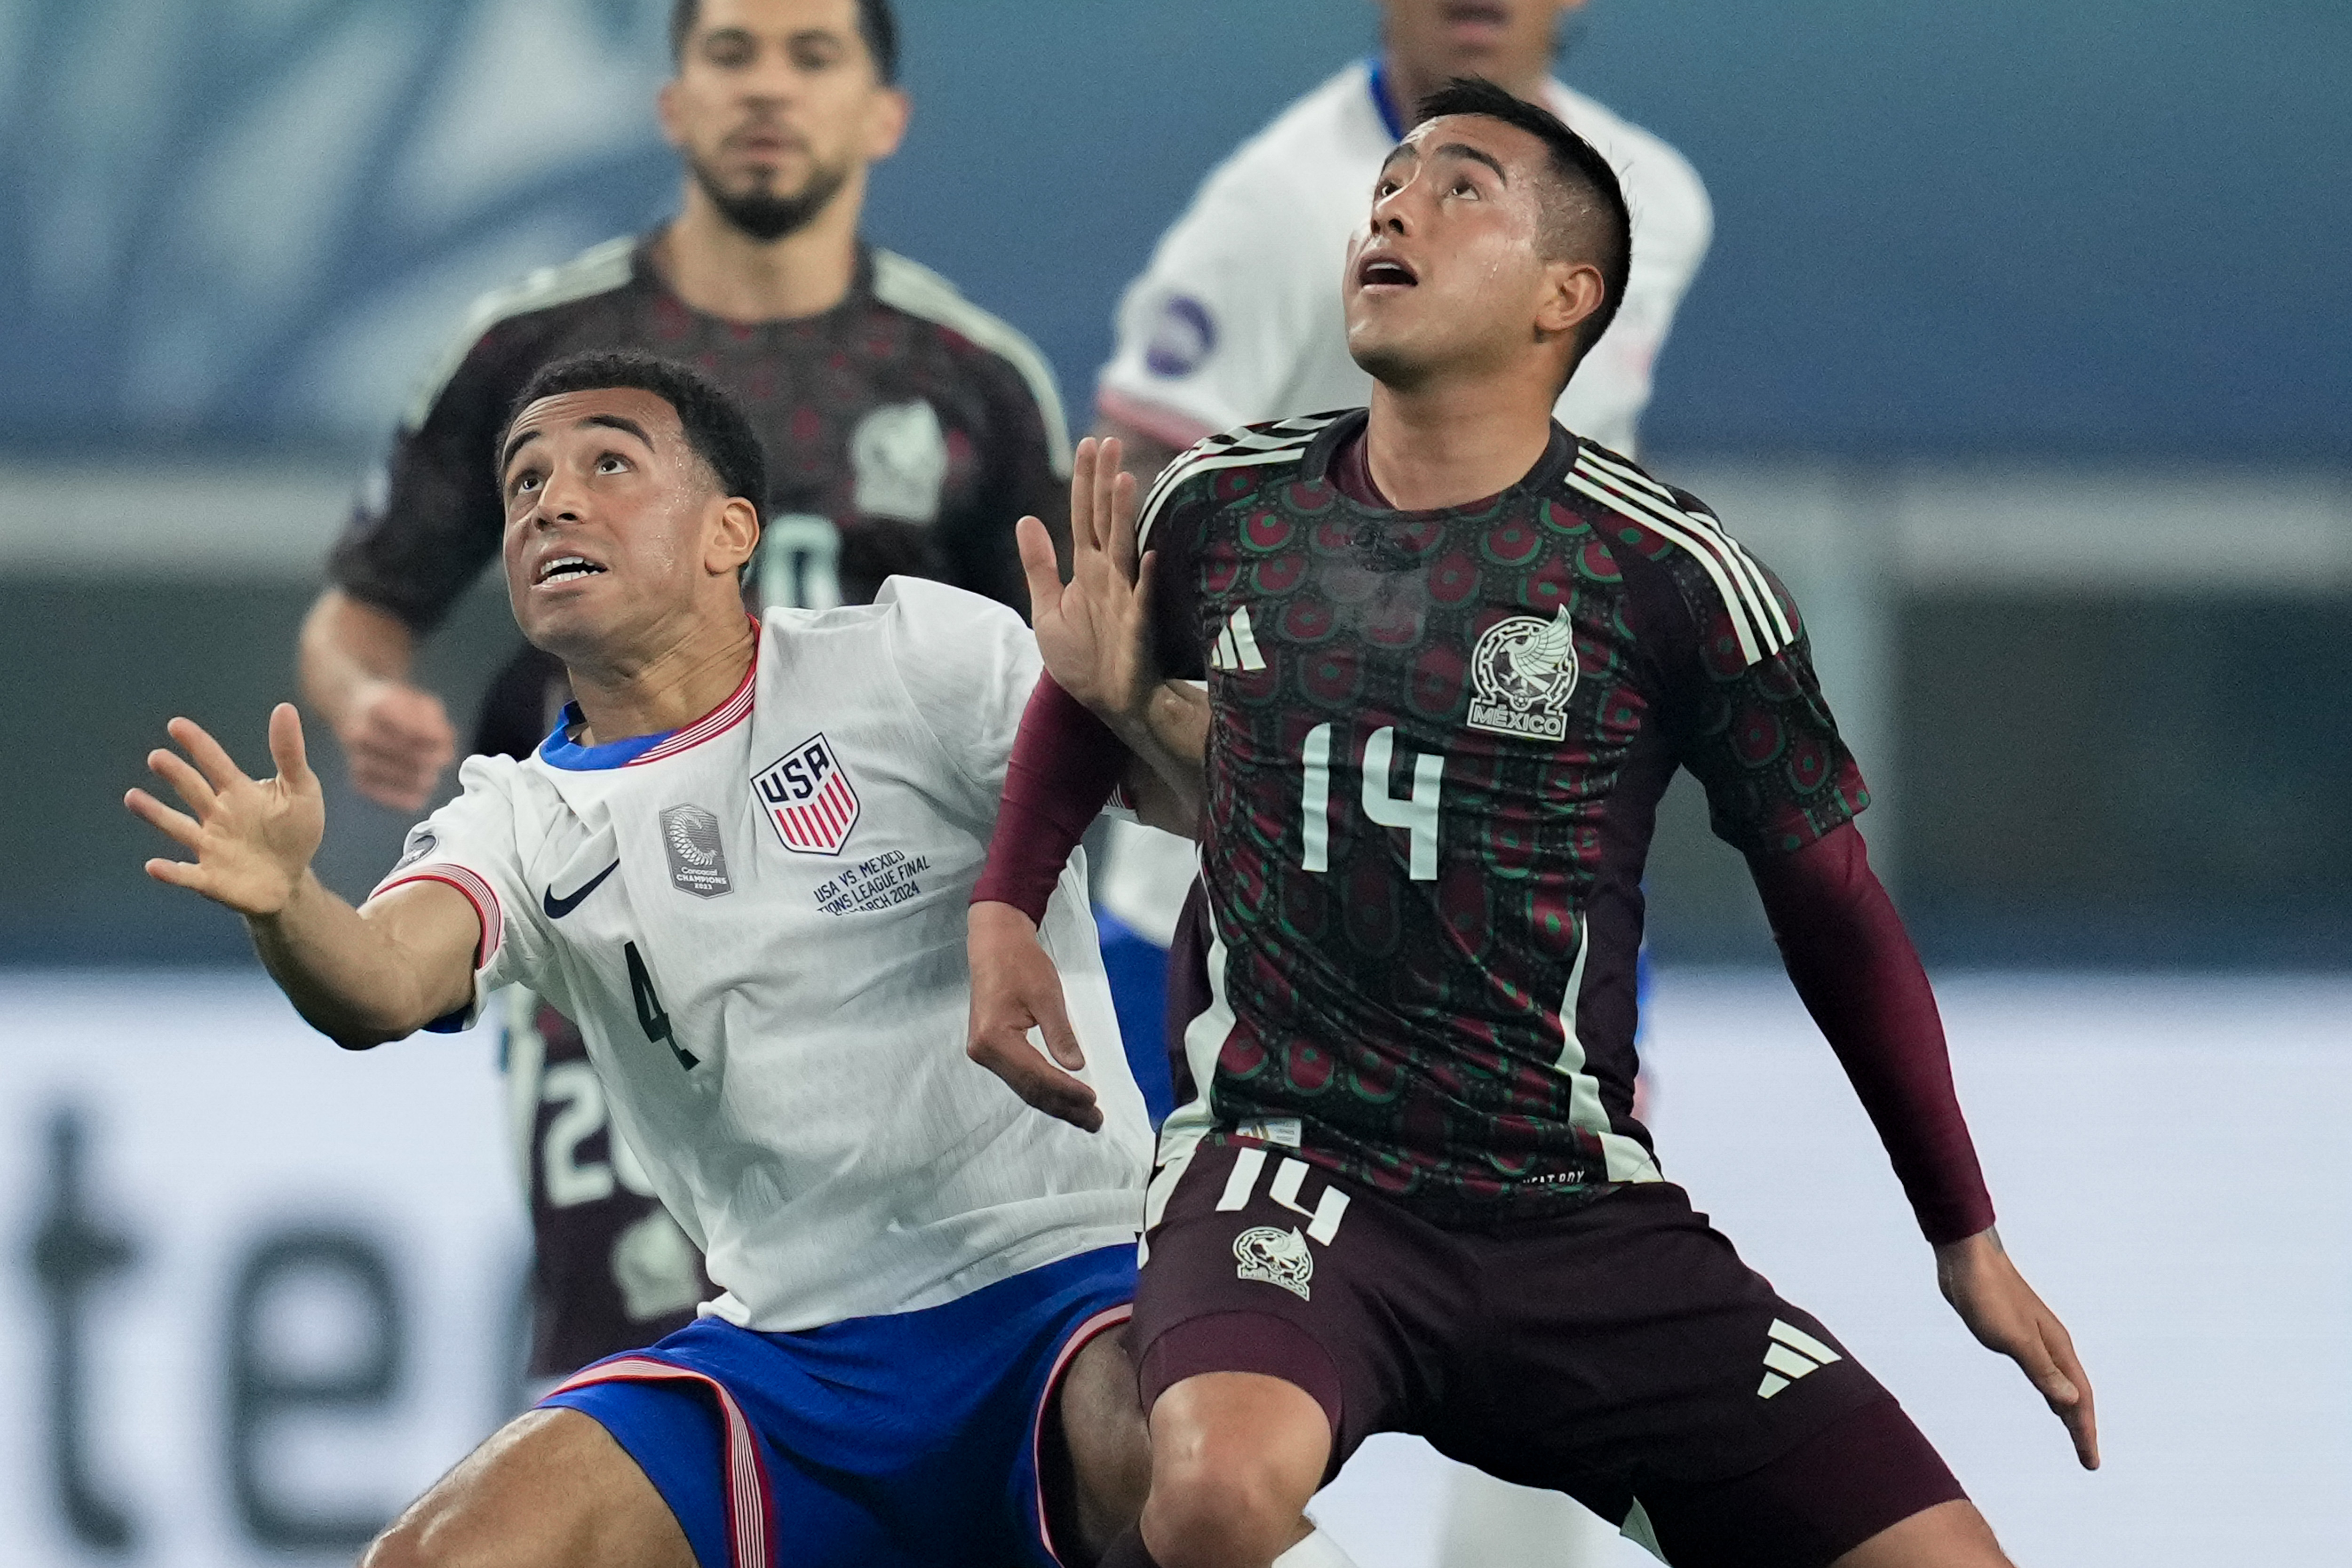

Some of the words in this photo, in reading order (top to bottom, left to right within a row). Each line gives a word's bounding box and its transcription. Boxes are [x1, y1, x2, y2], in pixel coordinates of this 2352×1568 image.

[755, 743, 830, 803] USA
[1302, 722, 1445, 881] 14
[676, 874, 727, 885] CHAMPIONS
[813, 881, 841, 903] USA
[838, 870, 861, 887] VS.
[858, 850, 906, 878] MEXICO
[851, 870, 898, 903] LEAGUE
[897, 855, 931, 881] FINAL
[890, 880, 921, 904] 2024
[624, 940, 700, 1072] 4
[1215, 1147, 1351, 1247] 14
